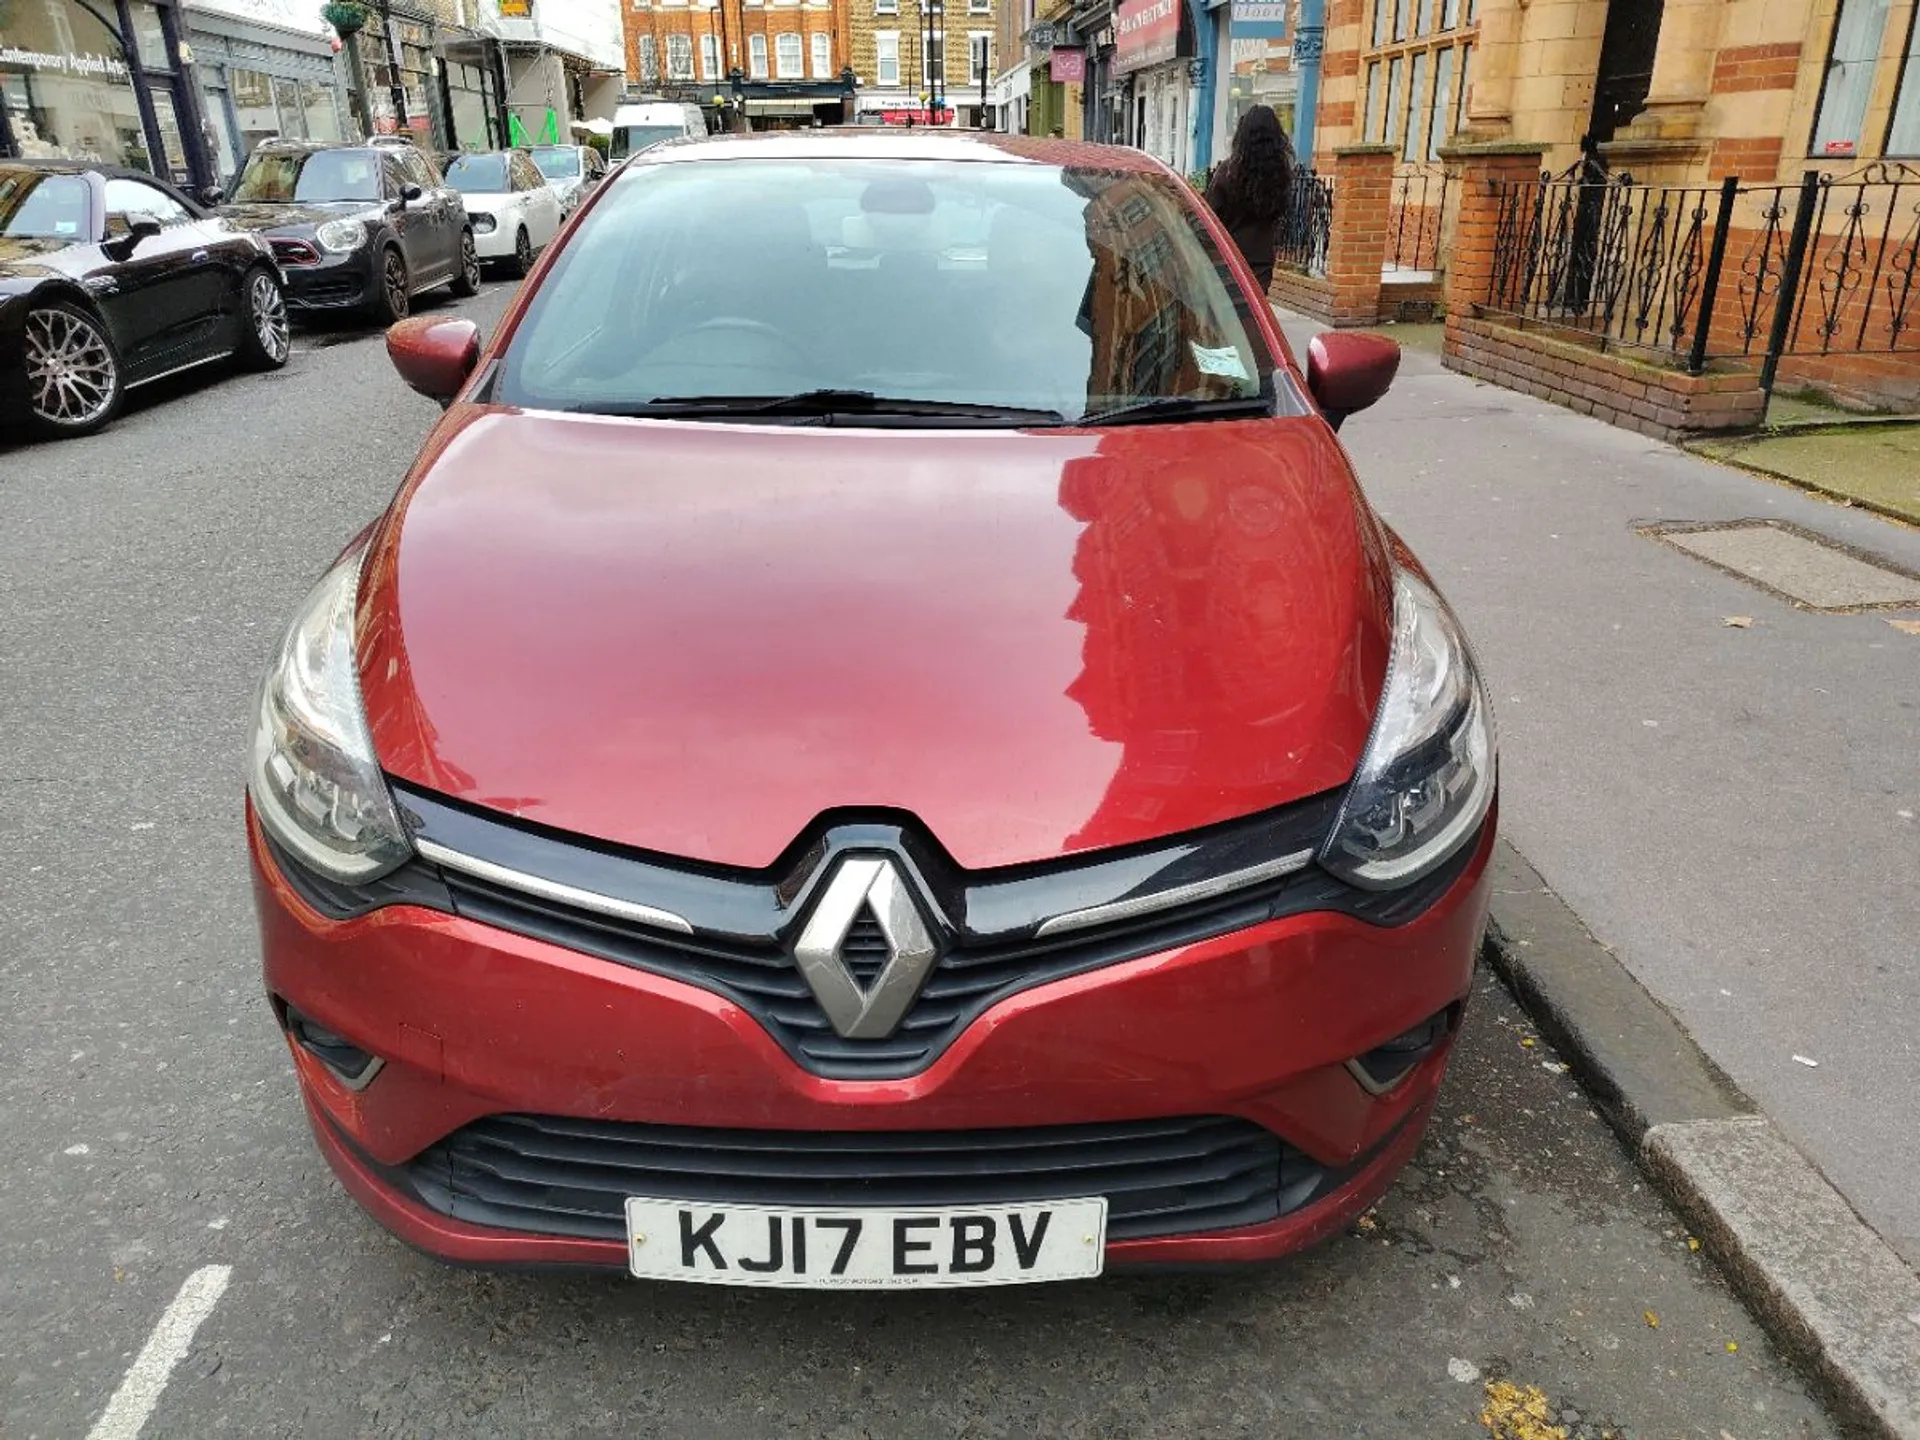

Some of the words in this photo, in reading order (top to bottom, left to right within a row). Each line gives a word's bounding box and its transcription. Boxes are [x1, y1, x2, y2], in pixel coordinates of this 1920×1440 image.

[70, 51, 105, 77] Applied
[106, 56, 125, 75] Arts
[678, 1209, 863, 1275] KJ17
[892, 1211, 1053, 1275] EBV
